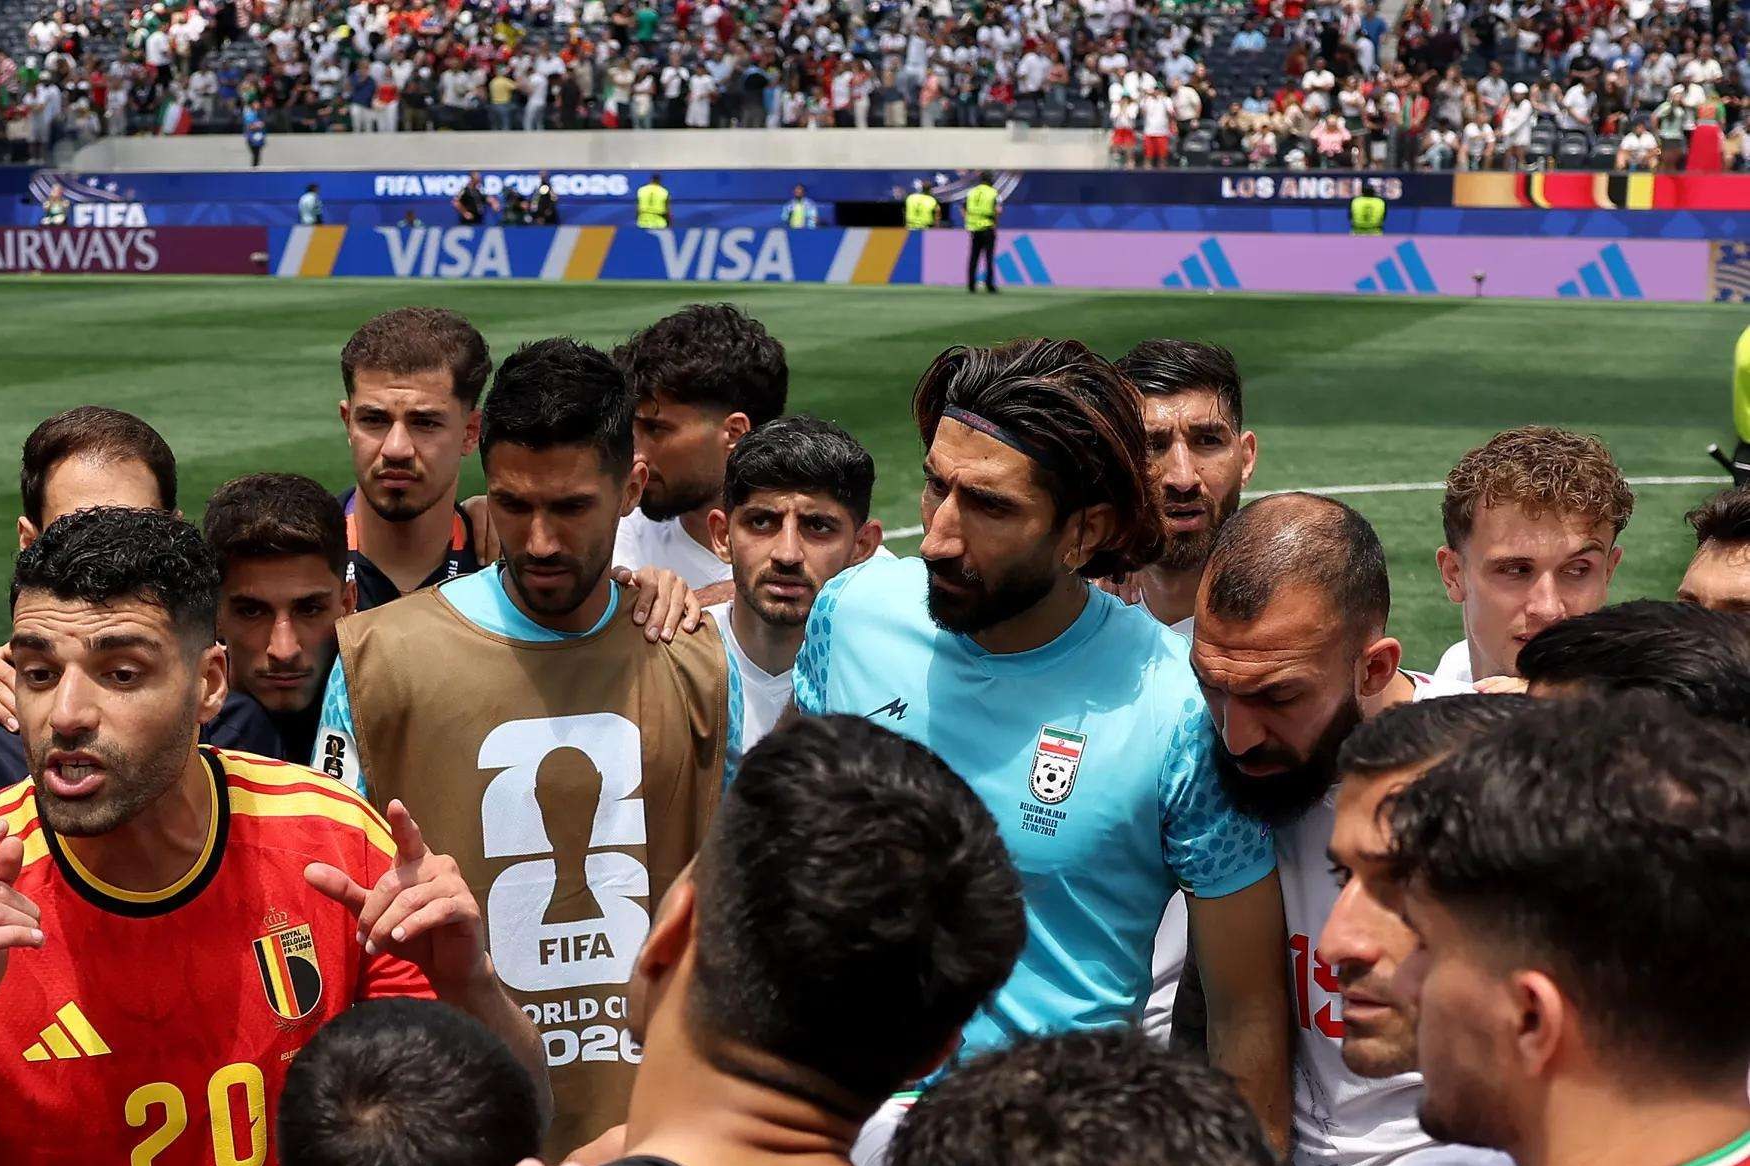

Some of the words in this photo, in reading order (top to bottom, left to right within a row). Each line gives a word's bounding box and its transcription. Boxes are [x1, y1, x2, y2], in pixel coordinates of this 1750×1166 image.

[374, 175, 423, 196] FIFA
[423, 174, 503, 196] WOD
[550, 174, 629, 196] 2026
[1221, 176, 1275, 199] LOS
[73, 202, 148, 228] FIFA
[375, 225, 511, 279] VISA
[648, 226, 796, 282] VISA
[280, 930, 301, 940] ROYAL
[282, 934, 310, 947] BELGIAN
[539, 933, 615, 965] FIFA
[521, 998, 599, 1025] ORLD
[541, 1025, 644, 1066] 026
